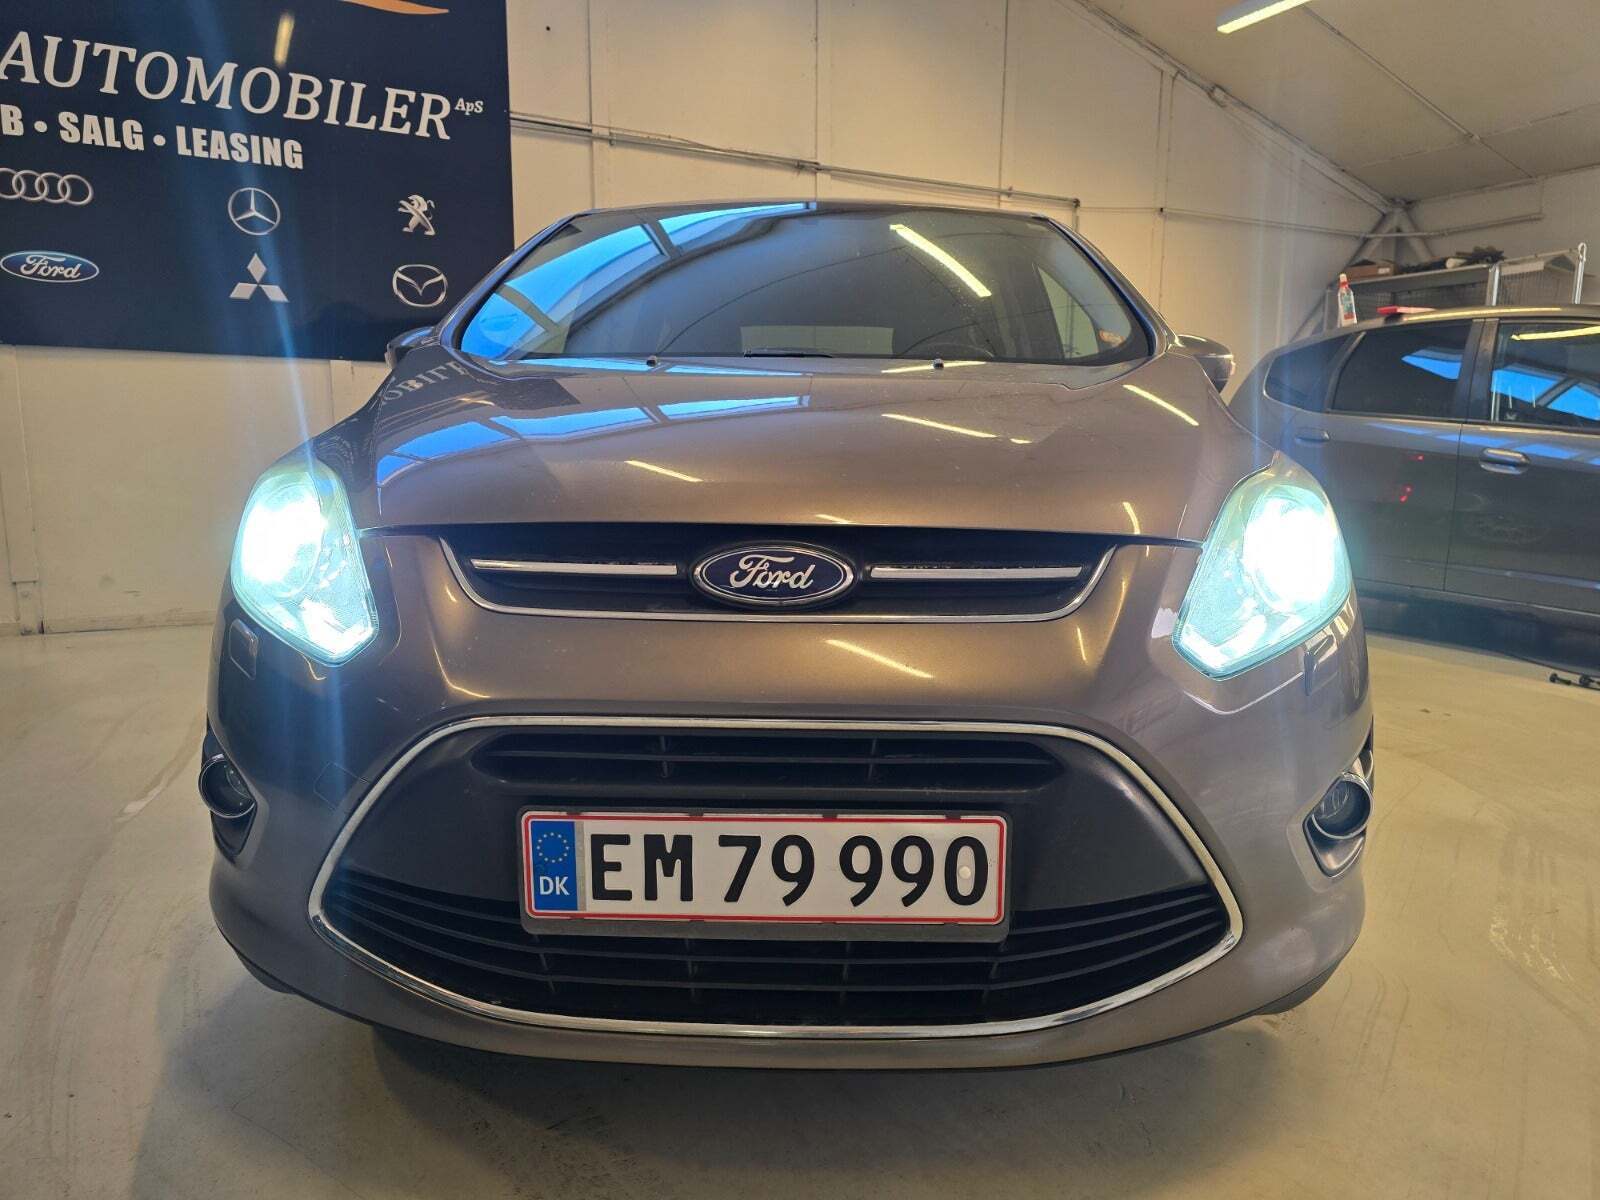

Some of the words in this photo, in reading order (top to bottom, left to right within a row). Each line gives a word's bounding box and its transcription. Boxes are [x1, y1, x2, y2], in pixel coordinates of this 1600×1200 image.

[0, 31, 451, 140] AUTOMOBILER
[455, 97, 484, 115] ApS
[58, 111, 145, 151] SALG
[177, 125, 304, 170] LEASING
[19, 253, 83, 280] Ford
[729, 554, 816, 589] Ford
[539, 876, 569, 896] DK
[590, 834, 693, 902] EM
[718, 834, 815, 907] 79
[839, 835, 989, 908] 990
